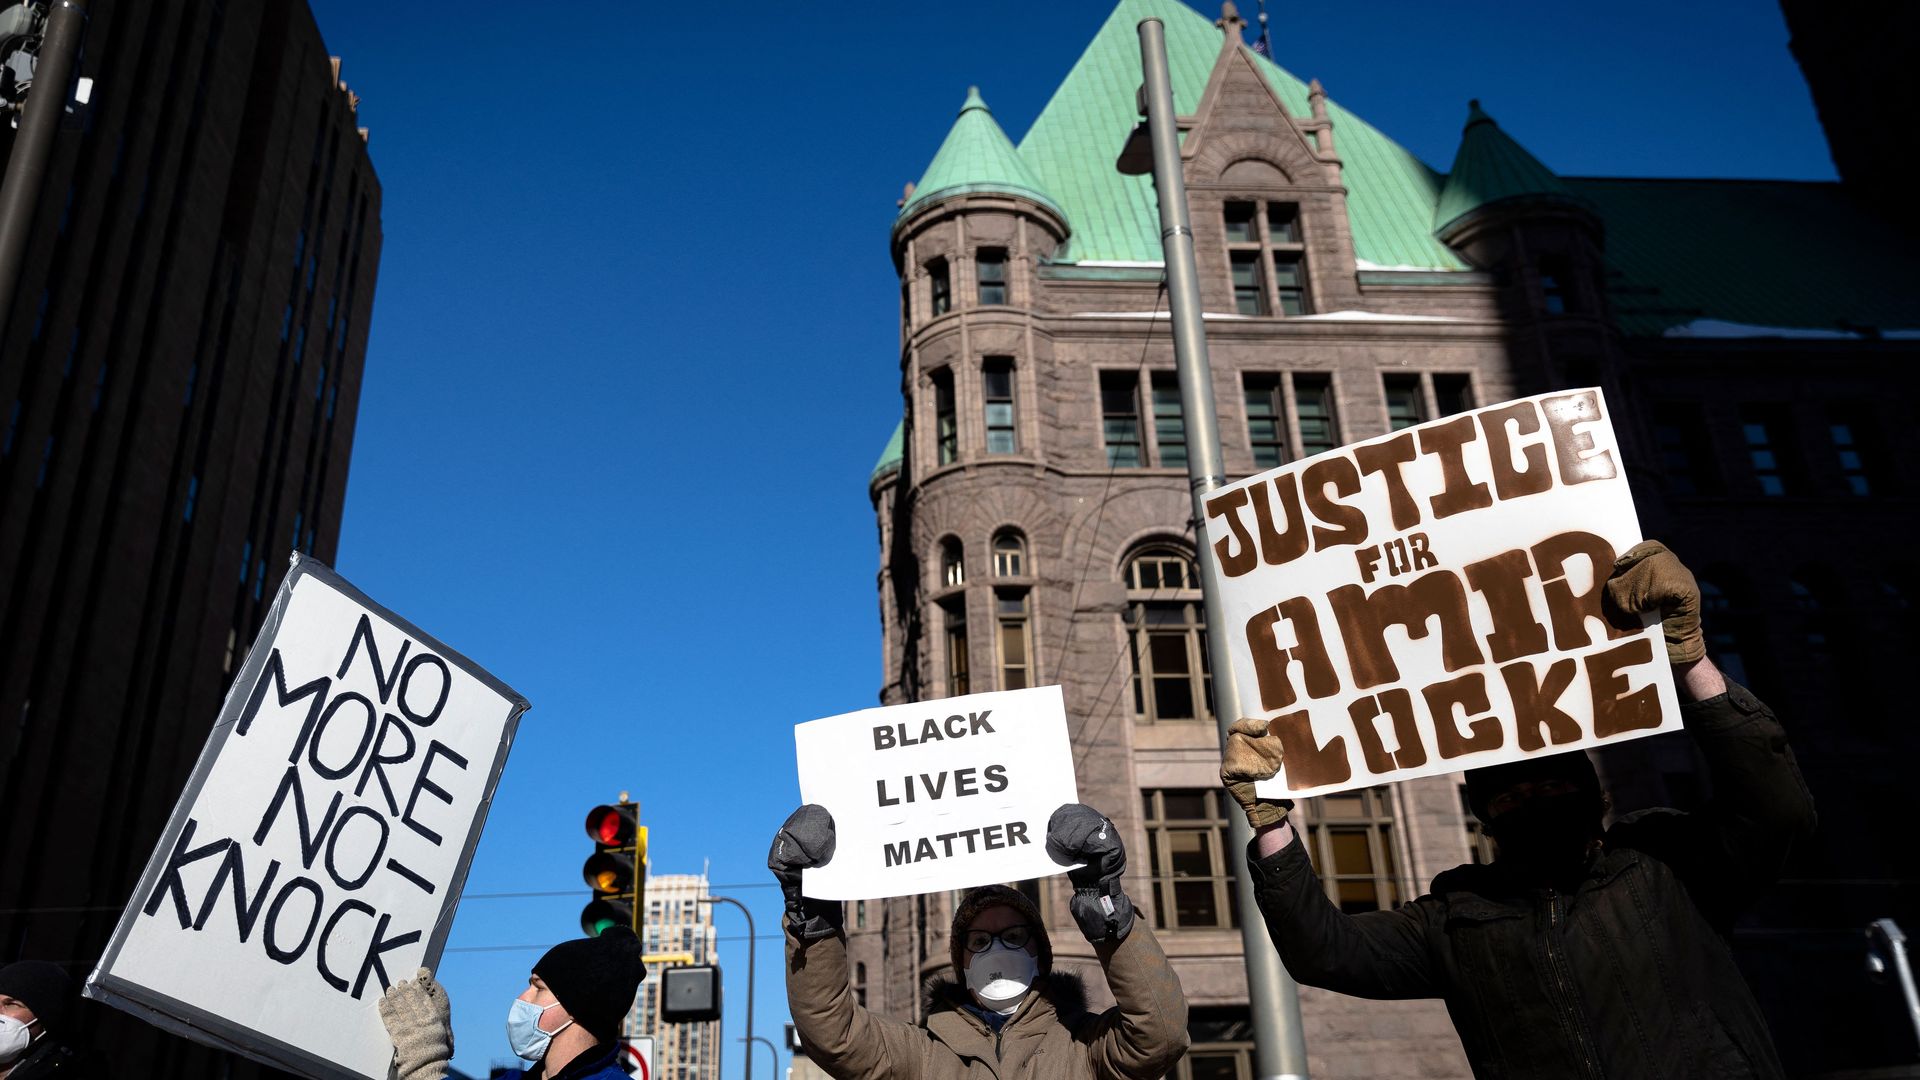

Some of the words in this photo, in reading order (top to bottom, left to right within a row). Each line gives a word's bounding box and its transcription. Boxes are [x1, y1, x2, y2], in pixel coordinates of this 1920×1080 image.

[1206, 389, 1618, 578] JUSTICE
[1245, 530, 1644, 713] AMIR
[1354, 532, 1440, 584] FOR
[336, 614, 452, 728] NO
[872, 710, 996, 751] BLACK
[1267, 637, 1663, 791] LOCKE
[235, 648, 469, 847] MORE
[876, 764, 1009, 807] LIVES
[252, 765, 436, 895] NO-
[883, 821, 1031, 868] MATTER
[143, 818, 423, 1001] KNOCK
